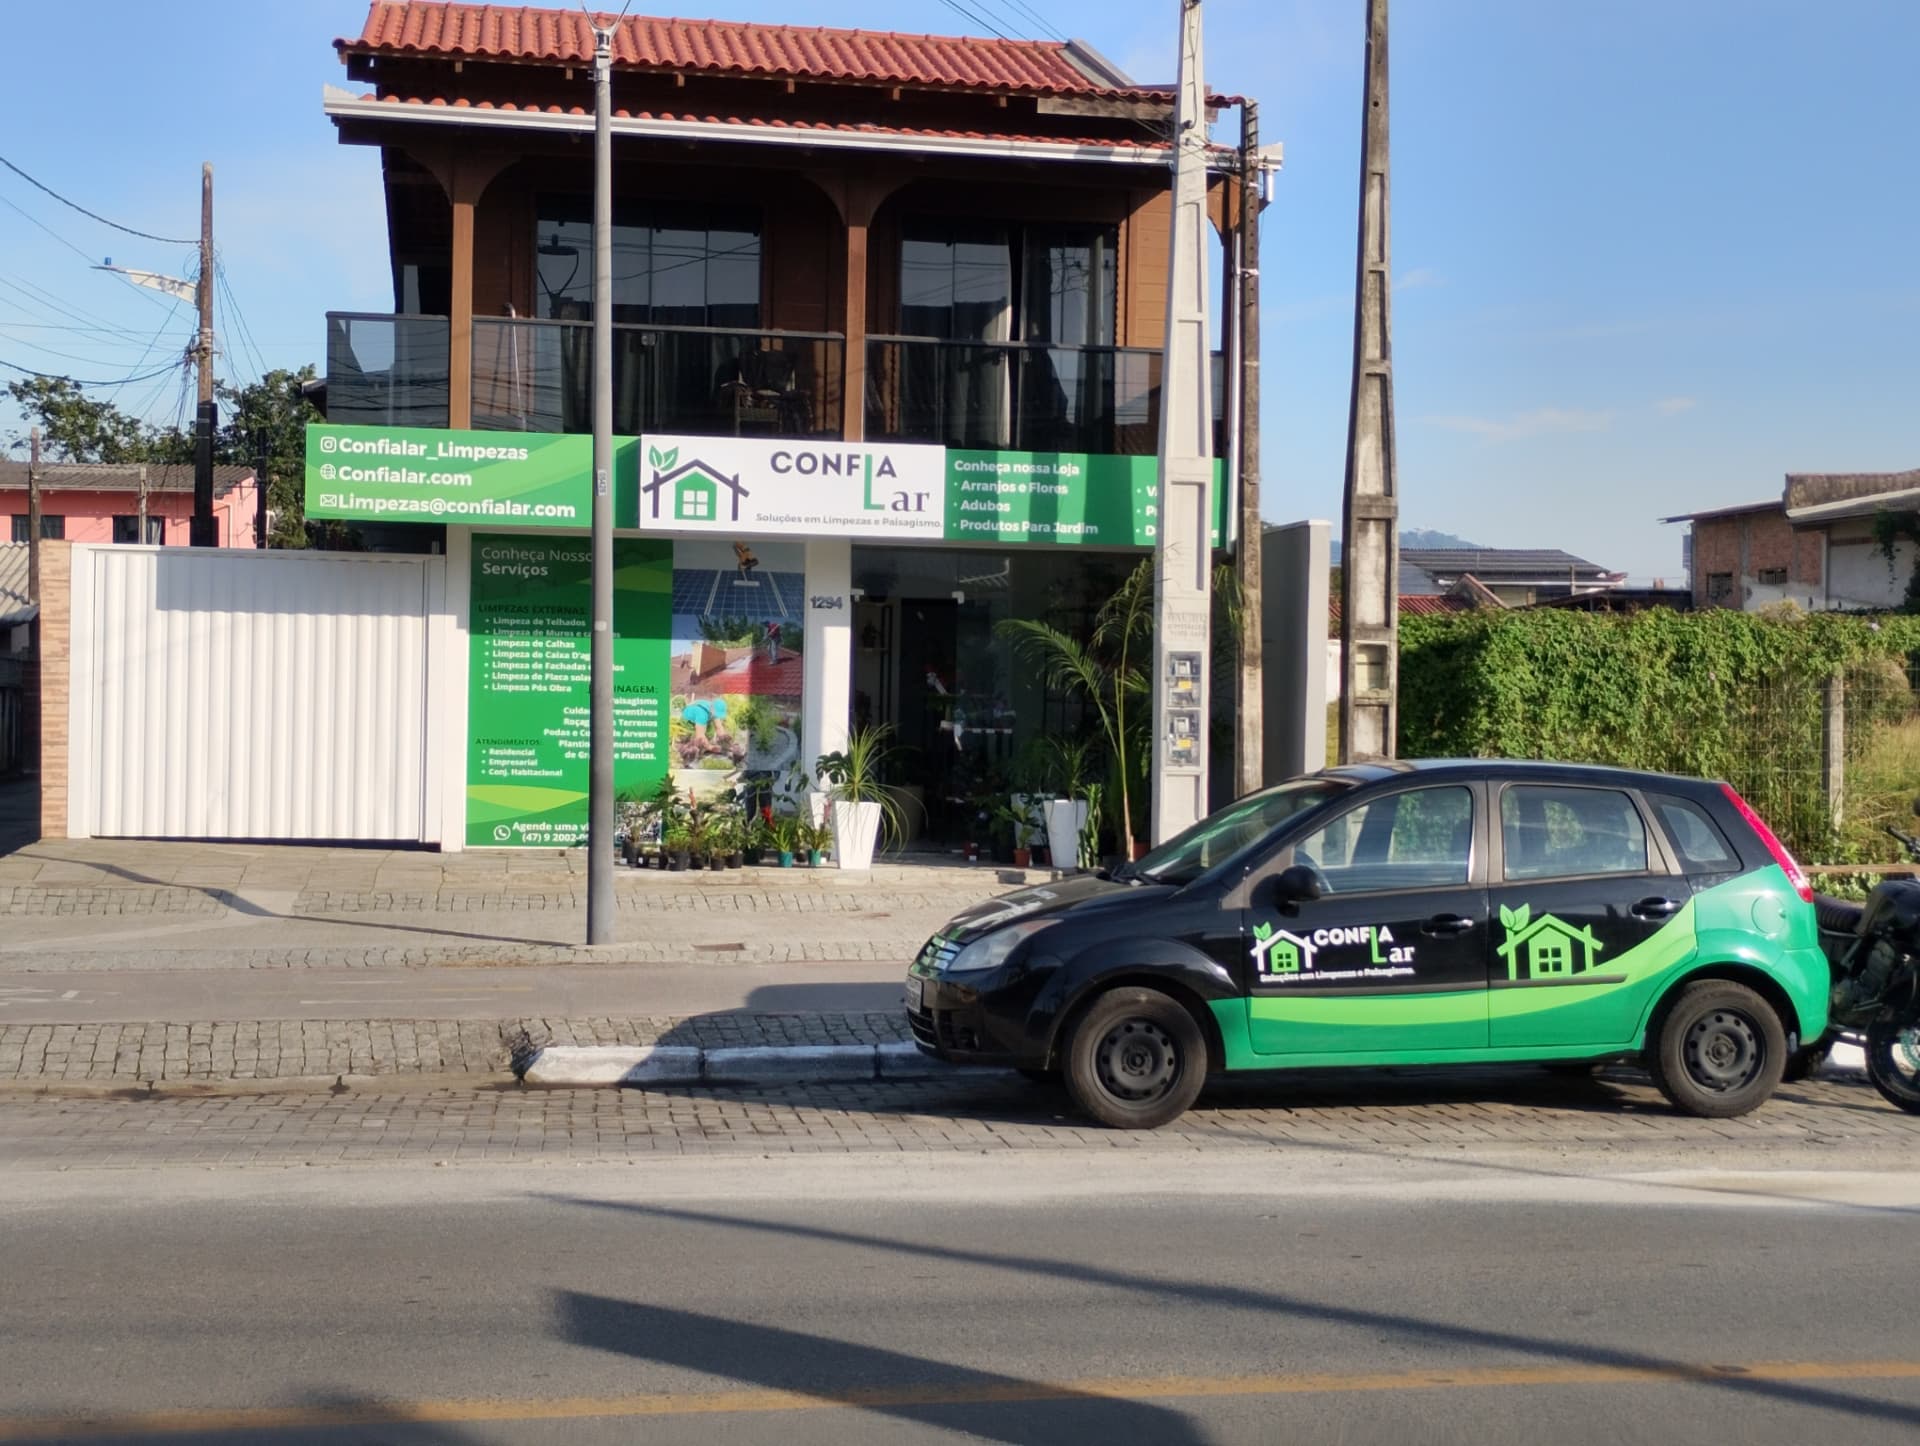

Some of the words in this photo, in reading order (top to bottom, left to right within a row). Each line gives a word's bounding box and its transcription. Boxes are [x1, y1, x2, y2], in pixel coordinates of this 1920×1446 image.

[339, 437, 528, 461] Confialar_Limpezas
[954, 460, 1010, 475] Conheça
[1013, 463, 1050, 474] nossa
[1053, 463, 1080, 476] Loja
[339, 465, 472, 486] Confialar.com
[961, 480, 1016, 494] Arranjos
[1018, 483, 1027, 493] e
[1029, 482, 1069, 494] Flores
[338, 492, 576, 517] Limpezas@confialar.com
[960, 500, 1010, 512] Adubos
[755, 512, 800, 525] Soluções
[804, 516, 821, 524] em
[823, 515, 872, 527] Limpezas
[874, 518, 881, 526] e
[882, 517, 943, 529] Paisagismo.
[960, 519, 1019, 532] Produtos
[1022, 520, 1050, 533] Para
[1053, 522, 1098, 535] Jardim
[481, 547, 545, 563] Conheça
[550, 549, 593, 562] Nosso
[482, 562, 549, 577] Serviços
[478, 604, 529, 614] LIMPEZAS
[493, 617, 530, 626] Limpeza
[545, 618, 586, 626] Telhados
[493, 628, 530, 637] Limpeza
[532, 629, 544, 637] de
[492, 639, 530, 648] Limpeza
[532, 640, 544, 648] de
[545, 640, 576, 649] Calhas
[492, 650, 530, 659] Limpeza
[532, 651, 543, 659] de
[492, 661, 530, 670] Limpeza
[532, 662, 543, 670] de
[545, 662, 586, 671] Fachadas
[491, 672, 530, 681] Limpeza
[531, 673, 543, 681] de
[491, 683, 530, 693] Limpeza
[612, 697, 658, 706] aisagismo
[618, 719, 658, 727] Terrenos
[543, 728, 571, 737] Podas
[564, 751, 576, 759] de
[511, 768, 563, 777] Habitacional
[512, 821, 552, 833] Agende
[554, 823, 578, 831] uma
[522, 832, 542, 843] (47)
[543, 833, 550, 842] 9
